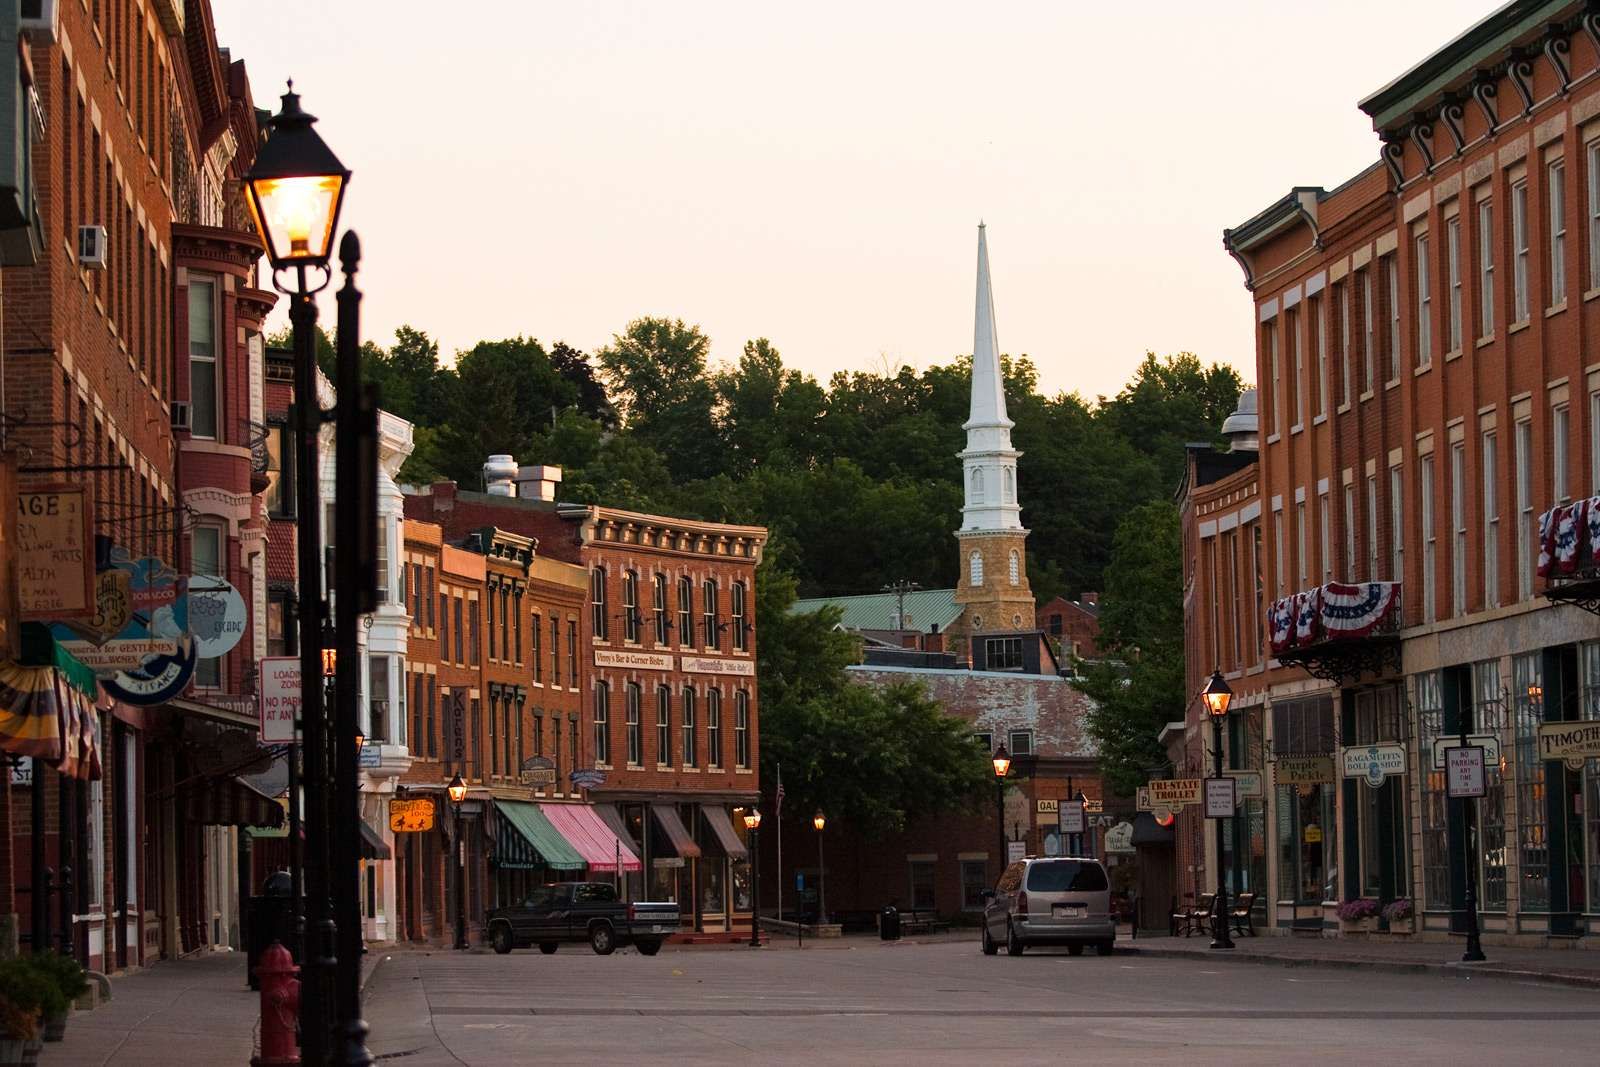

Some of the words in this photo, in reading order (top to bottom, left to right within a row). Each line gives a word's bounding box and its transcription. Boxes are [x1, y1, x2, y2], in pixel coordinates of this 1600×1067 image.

[265, 698, 279, 708] NO
[266, 711, 276, 720] AT
[1347, 752, 1402, 762] RAGAMUFFIN
[1281, 760, 1318, 772] Purple
[1380, 760, 1402, 768] SHOP
[1150, 780, 1199, 790] TRI-STATE
[1155, 790, 1196, 800] TROLLEY
[1087, 816, 1114, 828] EAT
